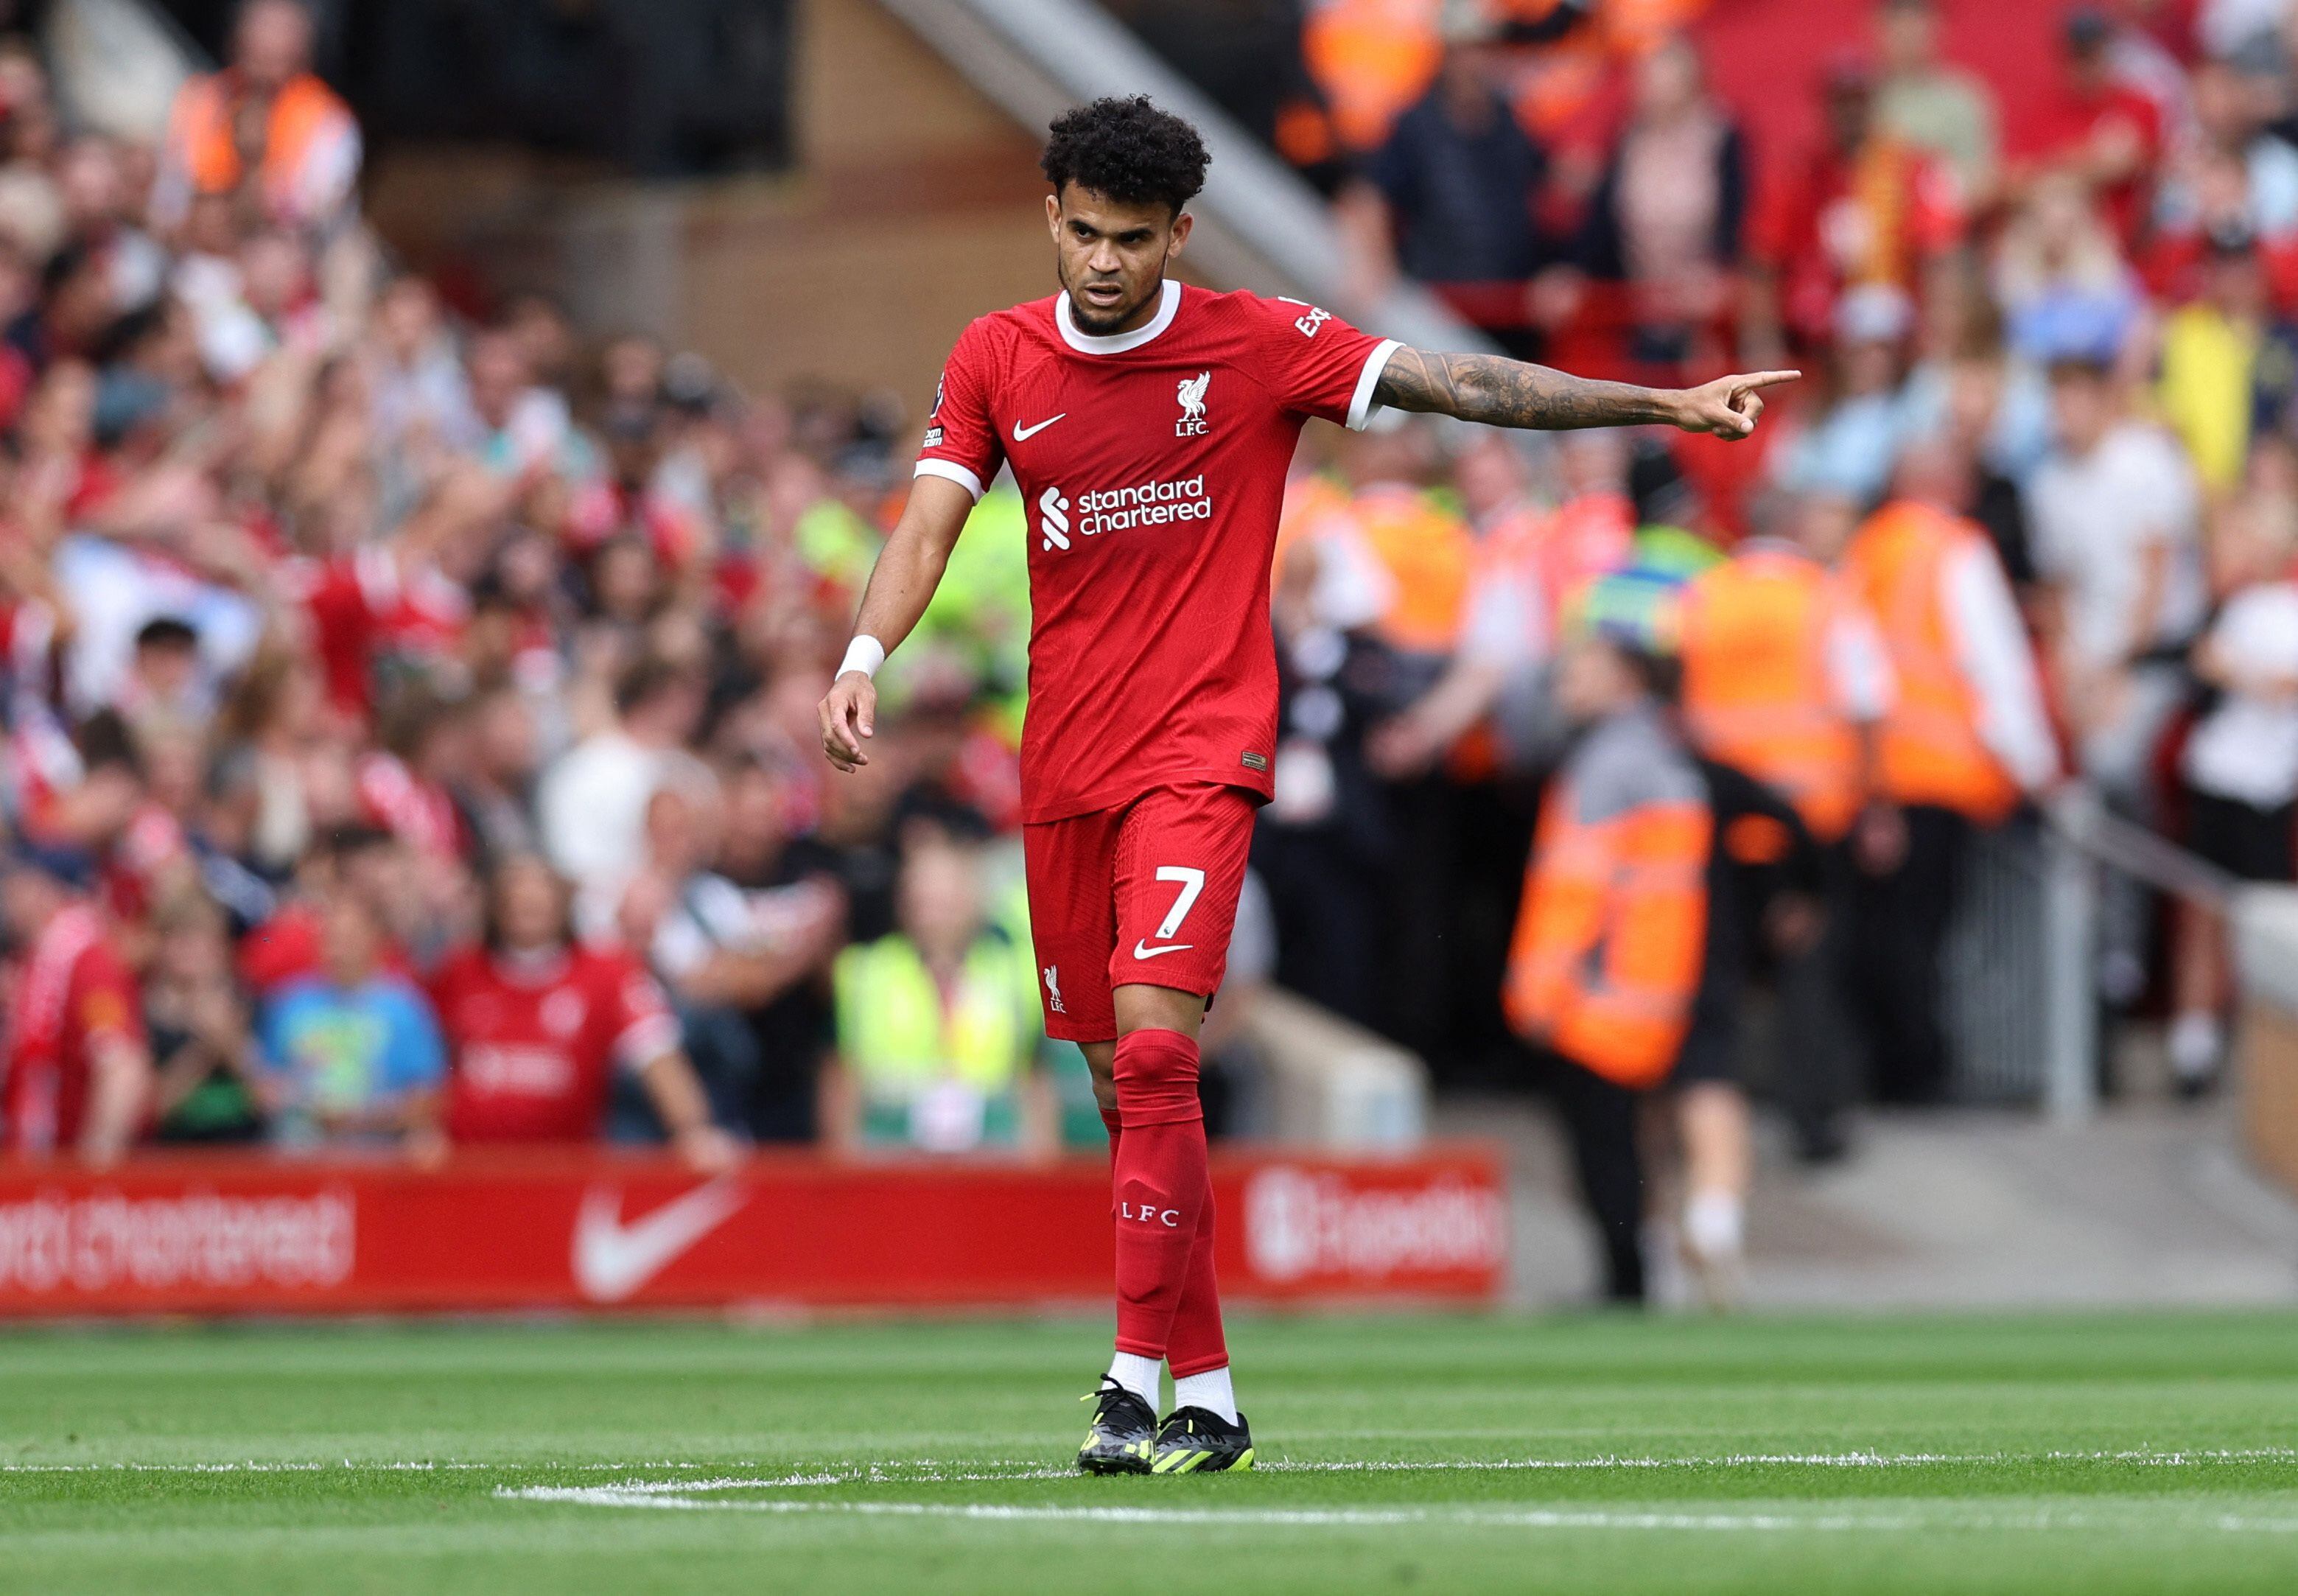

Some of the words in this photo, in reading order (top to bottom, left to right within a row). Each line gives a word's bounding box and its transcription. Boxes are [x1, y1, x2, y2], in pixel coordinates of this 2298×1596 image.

[1176, 421, 1209, 437] L.F.C.
[1079, 474, 1203, 514] standard
[1079, 496, 1211, 536] chartered
[1155, 865, 1206, 939] 7
